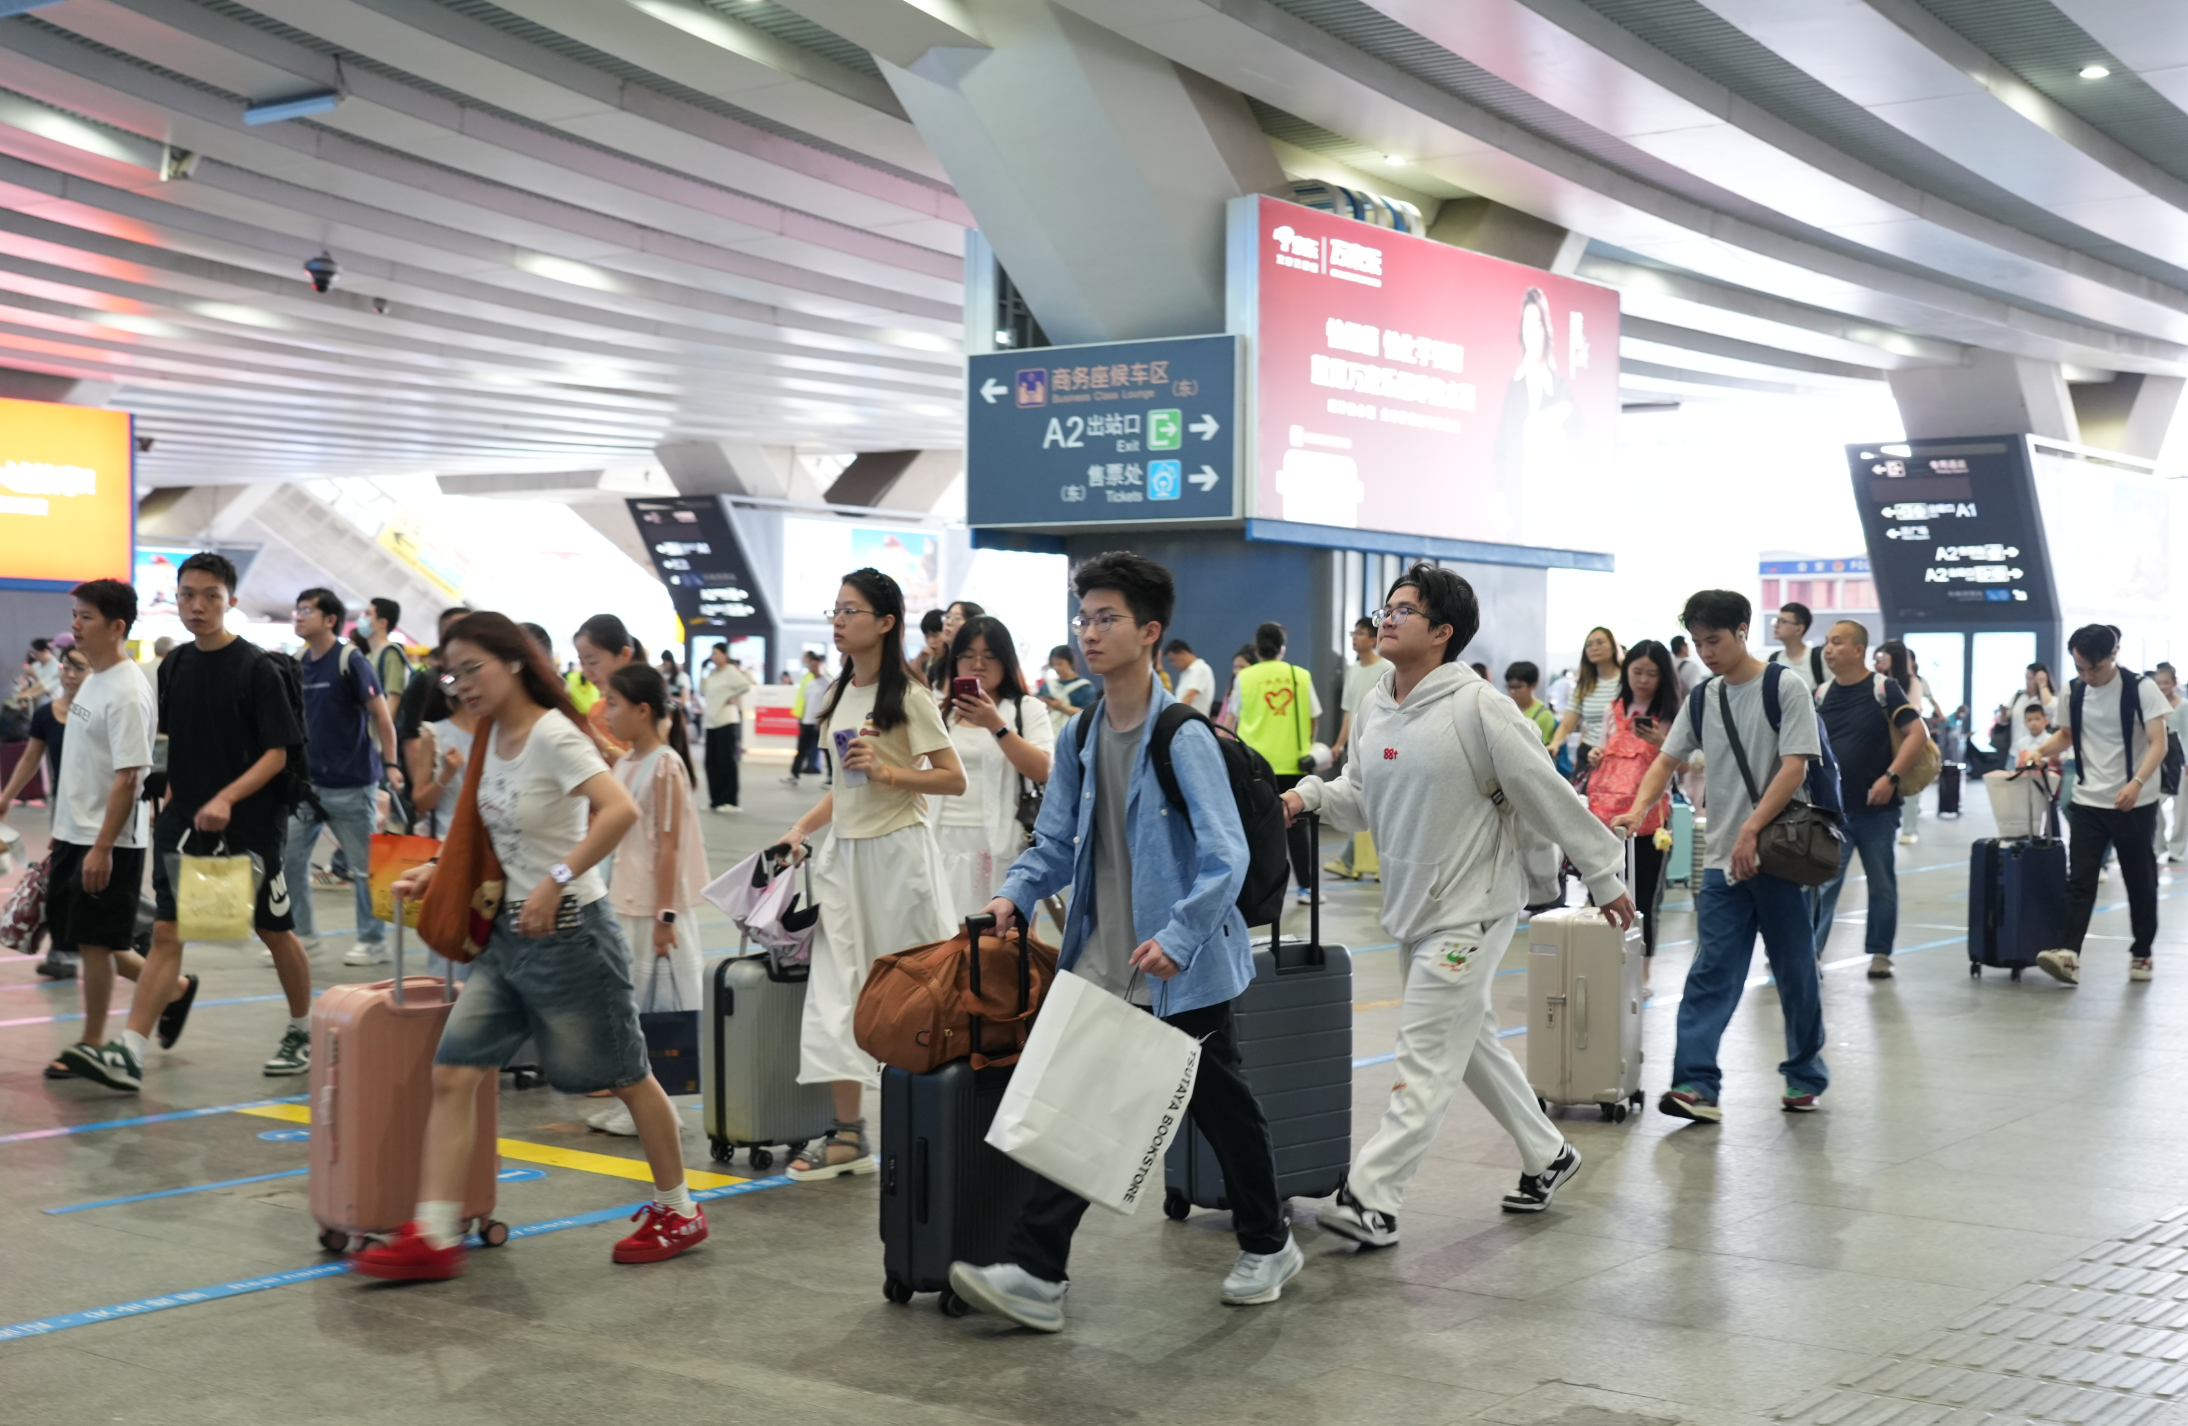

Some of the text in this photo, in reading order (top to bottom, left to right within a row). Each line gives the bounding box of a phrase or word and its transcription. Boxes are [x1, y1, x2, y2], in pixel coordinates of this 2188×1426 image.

[1051, 360, 1169, 391] 商务座候车区
[1042, 412, 1141, 449] A2 出站口
[1116, 439, 1140, 452] Exit
[1087, 463, 1143, 487] 售票处
[1105, 489, 1143, 502] Tickets
[1955, 503, 1977, 517] A1
[1935, 546, 1960, 561] A2
[1925, 567, 1949, 582] A2
[1122, 1050, 1197, 1204] TSUTAYA BOOKSTORE
